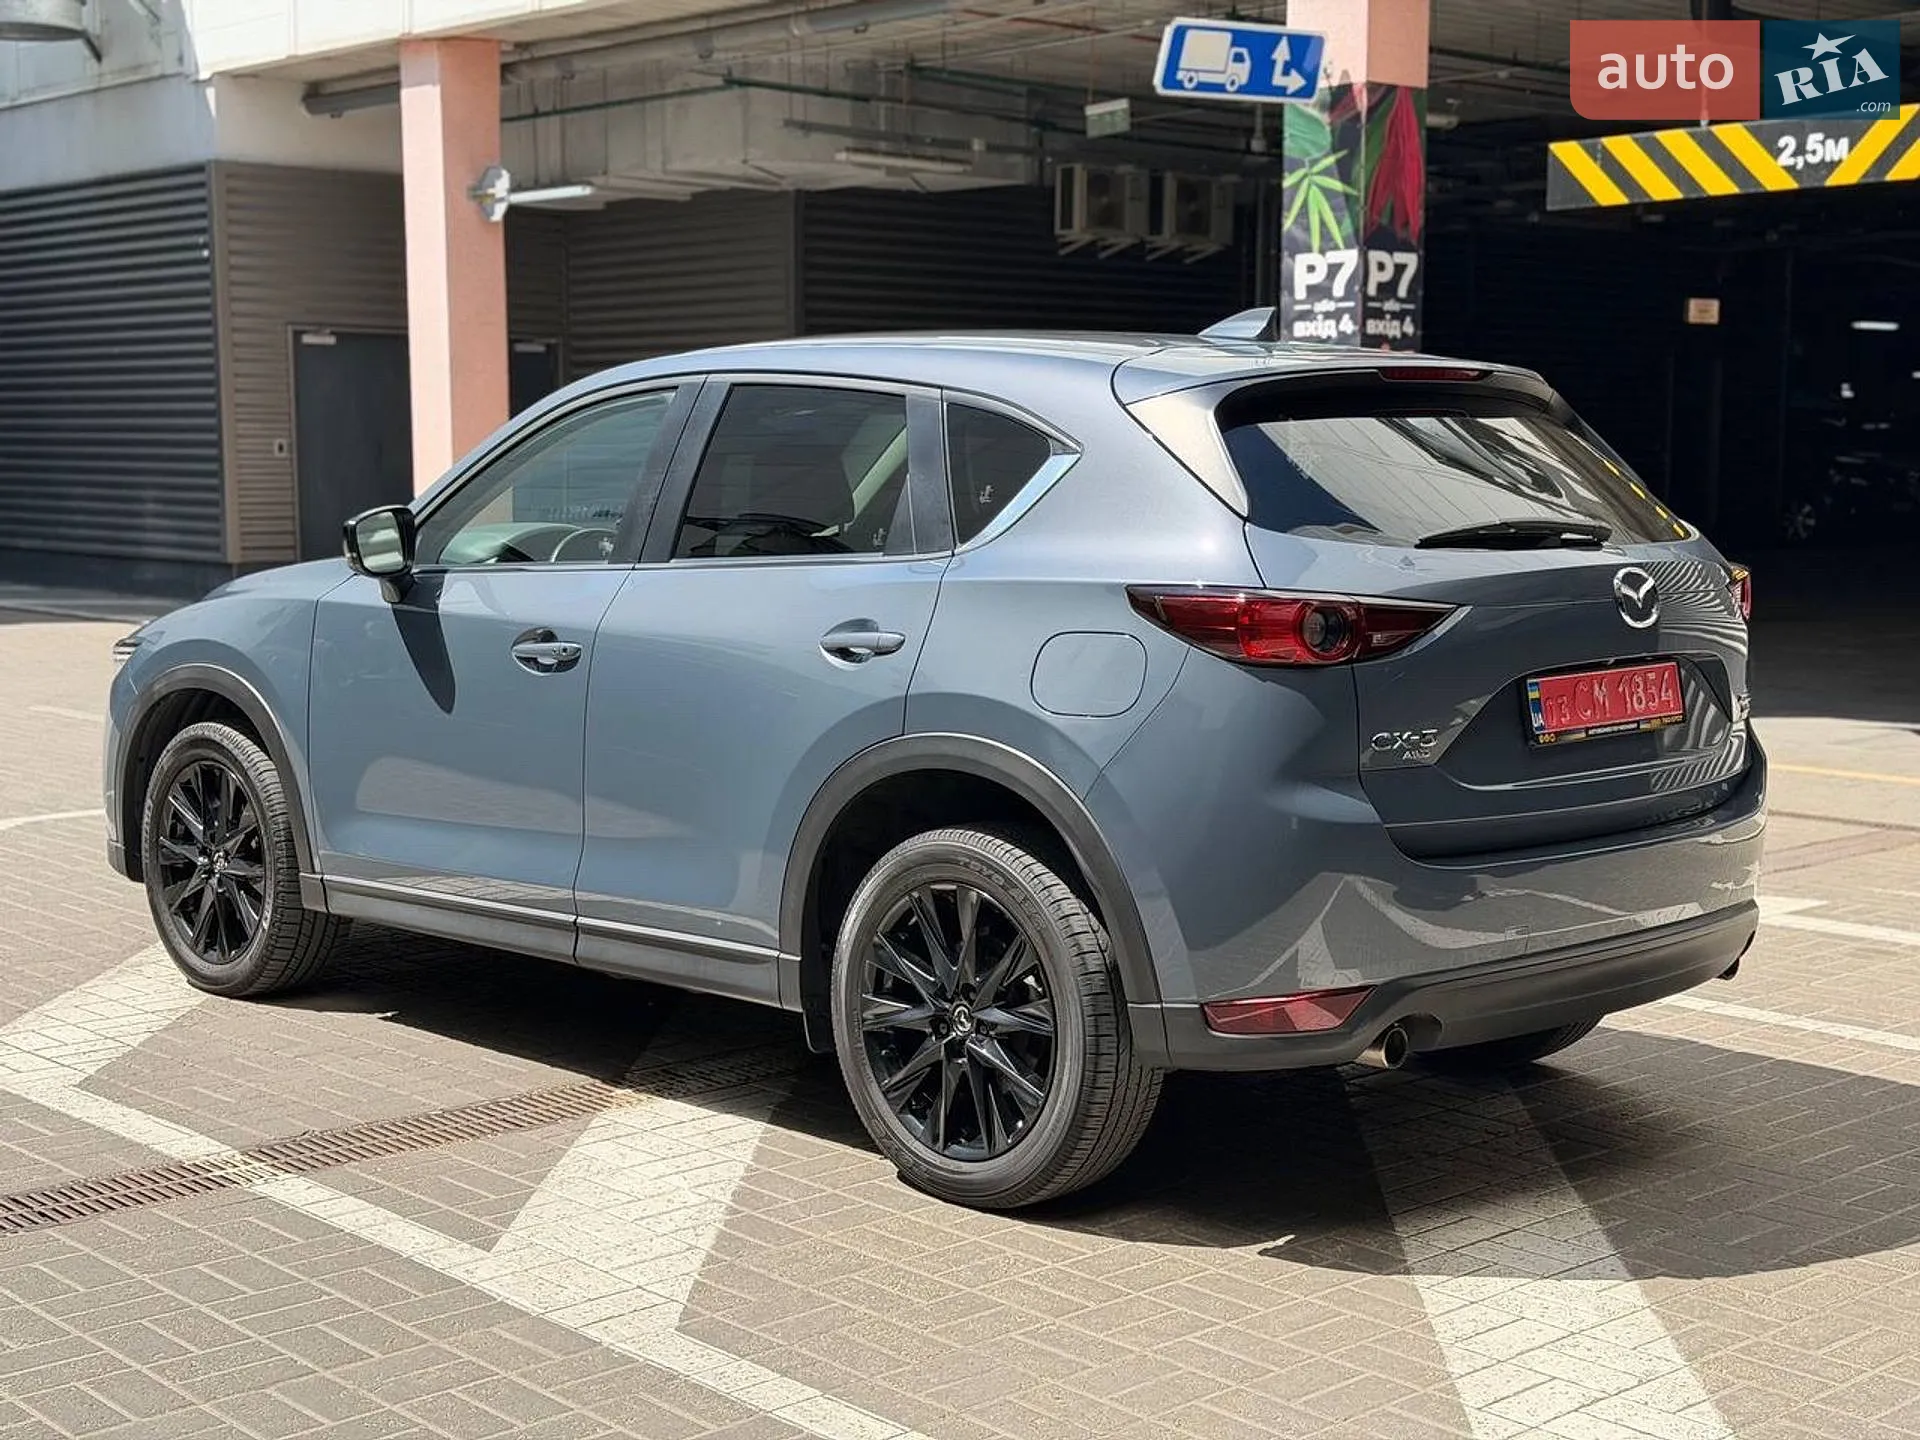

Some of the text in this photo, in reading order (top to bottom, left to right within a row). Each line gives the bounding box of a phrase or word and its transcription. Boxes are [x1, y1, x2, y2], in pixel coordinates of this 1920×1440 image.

[1294, 248, 1358, 300] P7
[1366, 250, 1418, 298] P7
[1293, 313, 1354, 339] вхід 4
[1366, 314, 1415, 339] вхід 4
[1617, 669, 1675, 715] 1854
[1531, 712, 1545, 728] UA
[1371, 728, 1438, 751] CX-5
